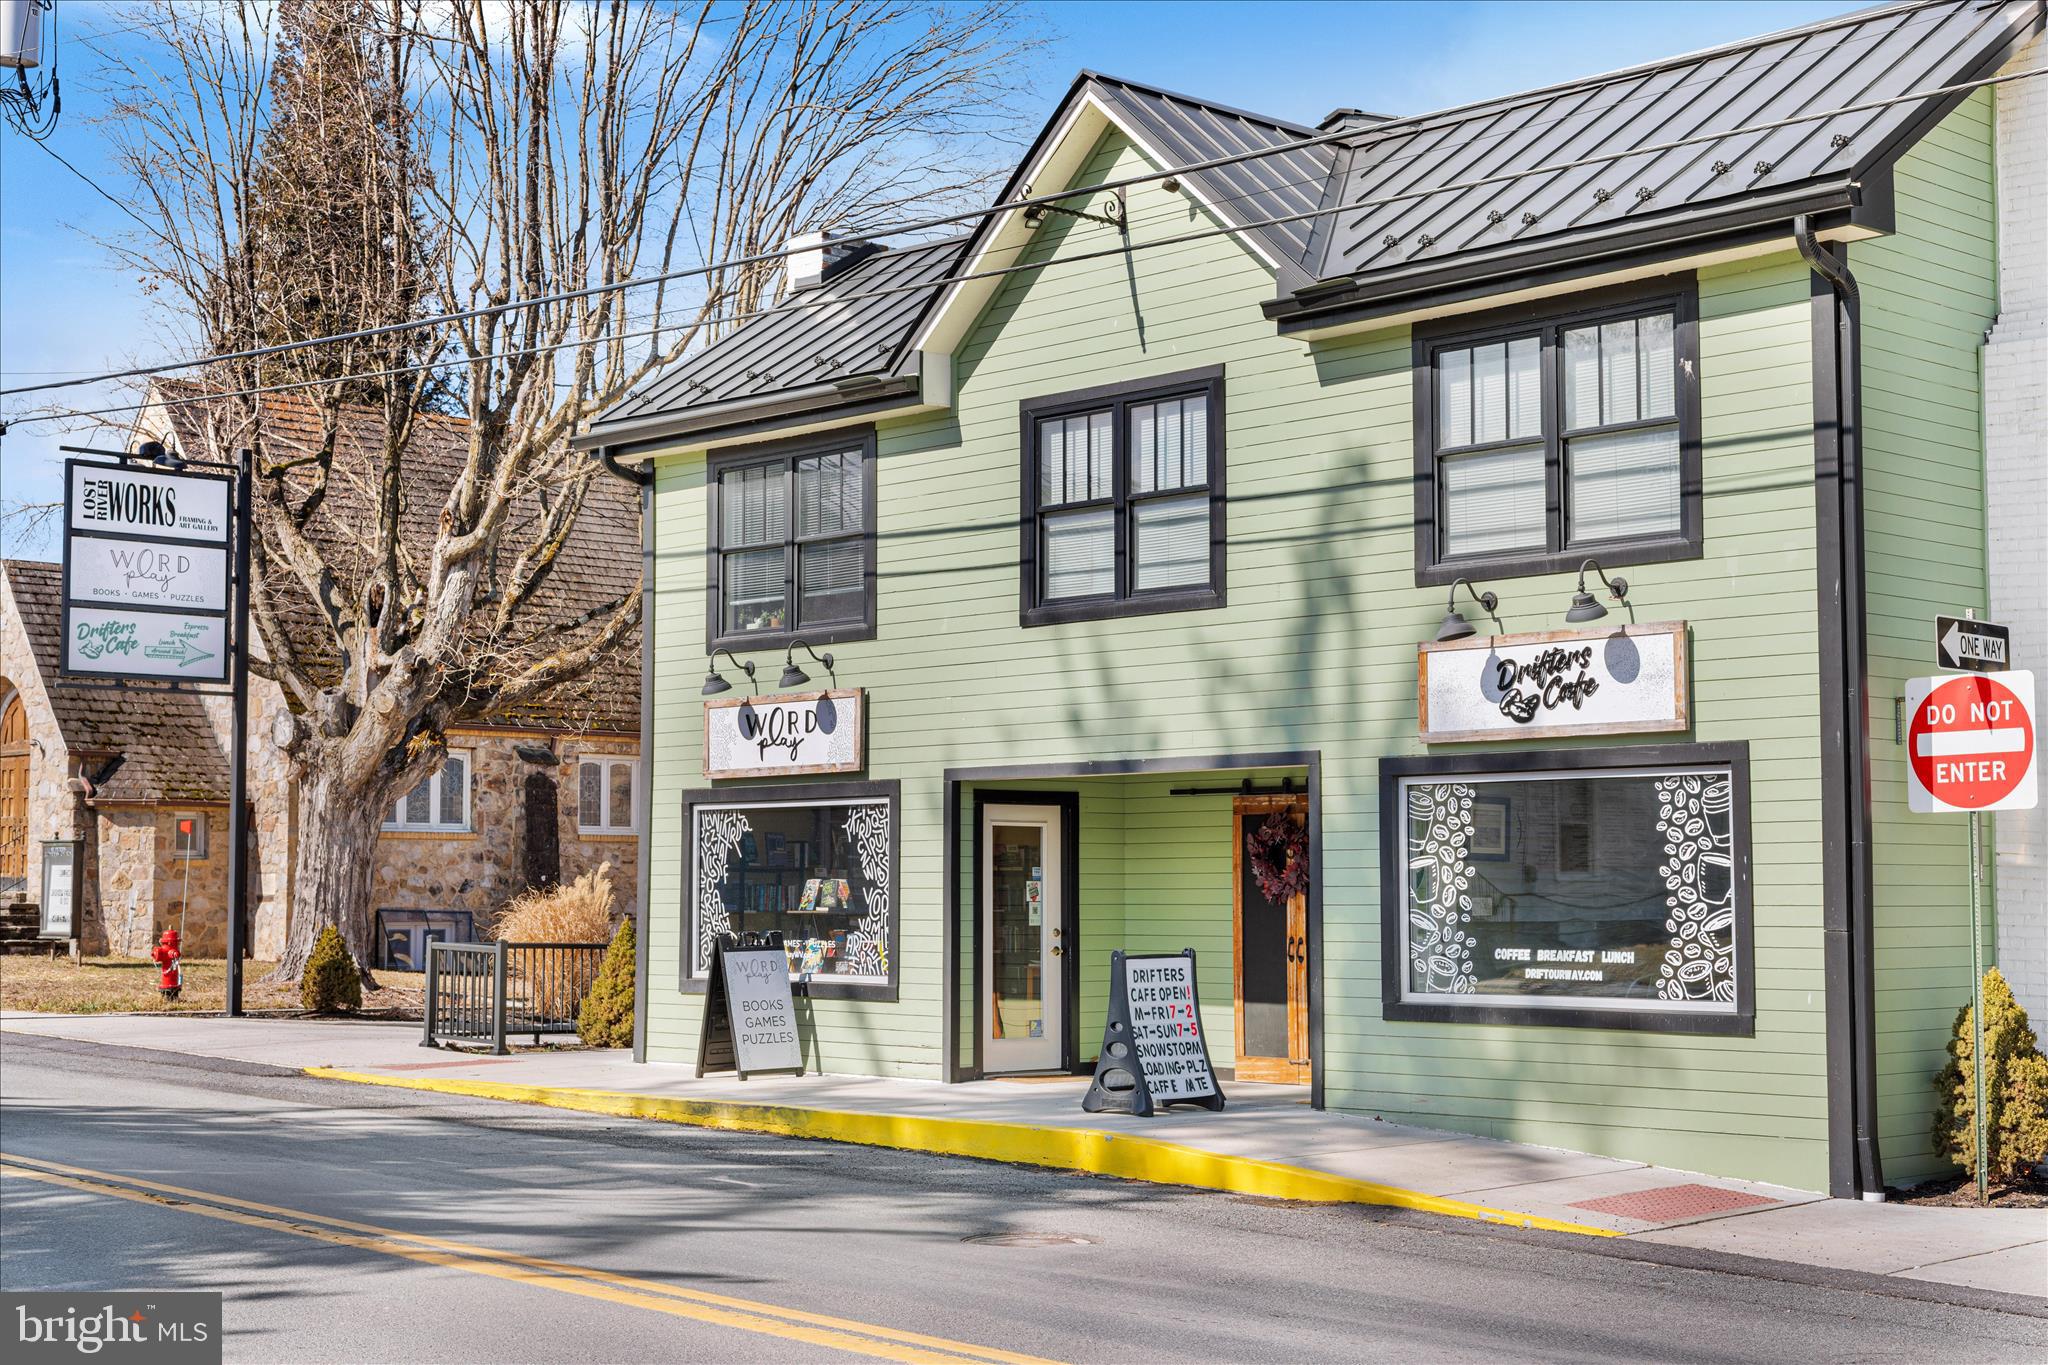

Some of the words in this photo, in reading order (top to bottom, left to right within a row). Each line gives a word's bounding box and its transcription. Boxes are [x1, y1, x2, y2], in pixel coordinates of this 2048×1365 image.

[83, 477, 97, 520] LOST
[97, 479, 108, 521] RIVER
[108, 480, 176, 527] WORKS
[179, 516, 206, 525] FRAMING
[192, 524, 219, 532] GALLERY
[110, 549, 190, 574] WORD
[123, 570, 176, 592] play
[93, 588, 120, 596] BOOKS
[132, 591, 159, 599] GAMES
[170, 594, 204, 602] PUZZLES
[77, 620, 137, 641] Drifters
[106, 635, 140, 656] Cafe
[1960, 635, 1980, 657] ONE
[1983, 638, 2003, 660] WAY
[1497, 646, 1592, 691] Drifters
[1543, 670, 1600, 711] Cafe
[745, 707, 818, 738] WORD
[1927, 704, 1956, 726] DO
[1970, 700, 2013, 723] NOT
[757, 737, 804, 762] play
[1936, 761, 2007, 784] ENTER
[1494, 948, 1531, 961] COFFEE
[1537, 949, 1595, 963] BREAKFAST
[1601, 951, 1635, 964] LUNCH
[736, 958, 778, 974] WORD
[1133, 968, 1185, 983] DRIFTERS
[1525, 968, 1603, 981] DRIFTOURWAY.COM
[746, 971, 772, 984] play
[1131, 988, 1156, 1002] CAFE
[1159, 985, 1191, 1000] OPEN!
[742, 1000, 784, 1012] BOOKS
[745, 1016, 786, 1028] GAMES
[742, 1032, 794, 1045] PUZZLES
[1137, 1041, 1202, 1058] SNOWSTORM
[1187, 1059, 1207, 1074] PLZ
